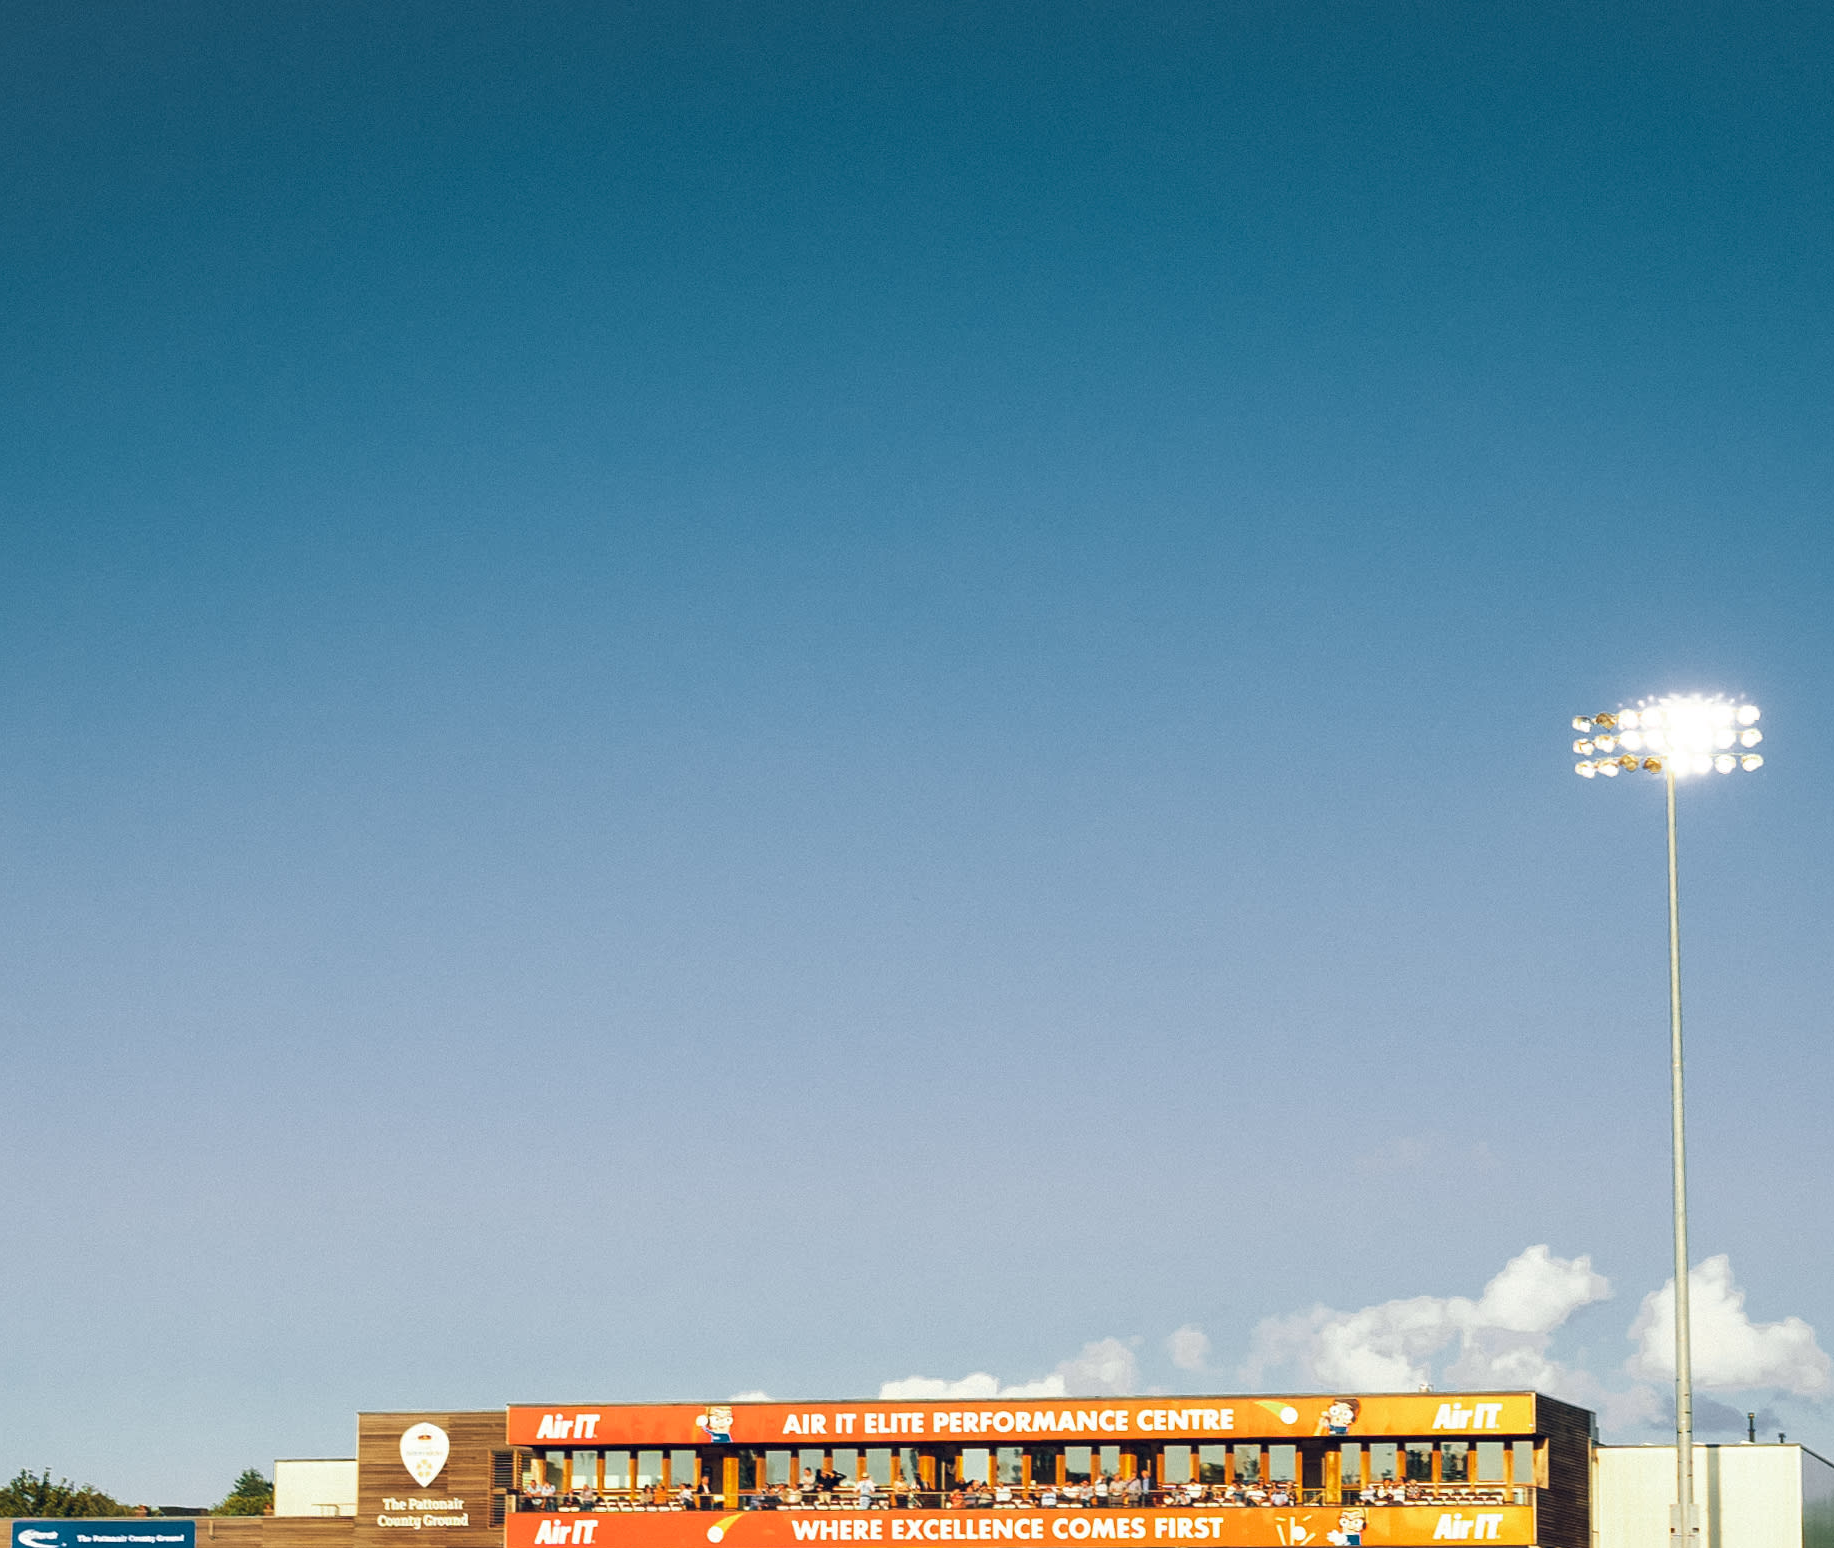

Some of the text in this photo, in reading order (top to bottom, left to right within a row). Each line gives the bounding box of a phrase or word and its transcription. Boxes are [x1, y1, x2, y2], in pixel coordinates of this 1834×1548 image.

[783, 1409, 1234, 1434] AIR IT ELITE PERFORMANCE CENTRE
[383, 1498, 465, 1511] The Pattonair
[377, 1514, 469, 1529] County Ground
[791, 1517, 1224, 1541] WHERE EXCELLENCE COMES FIRST
